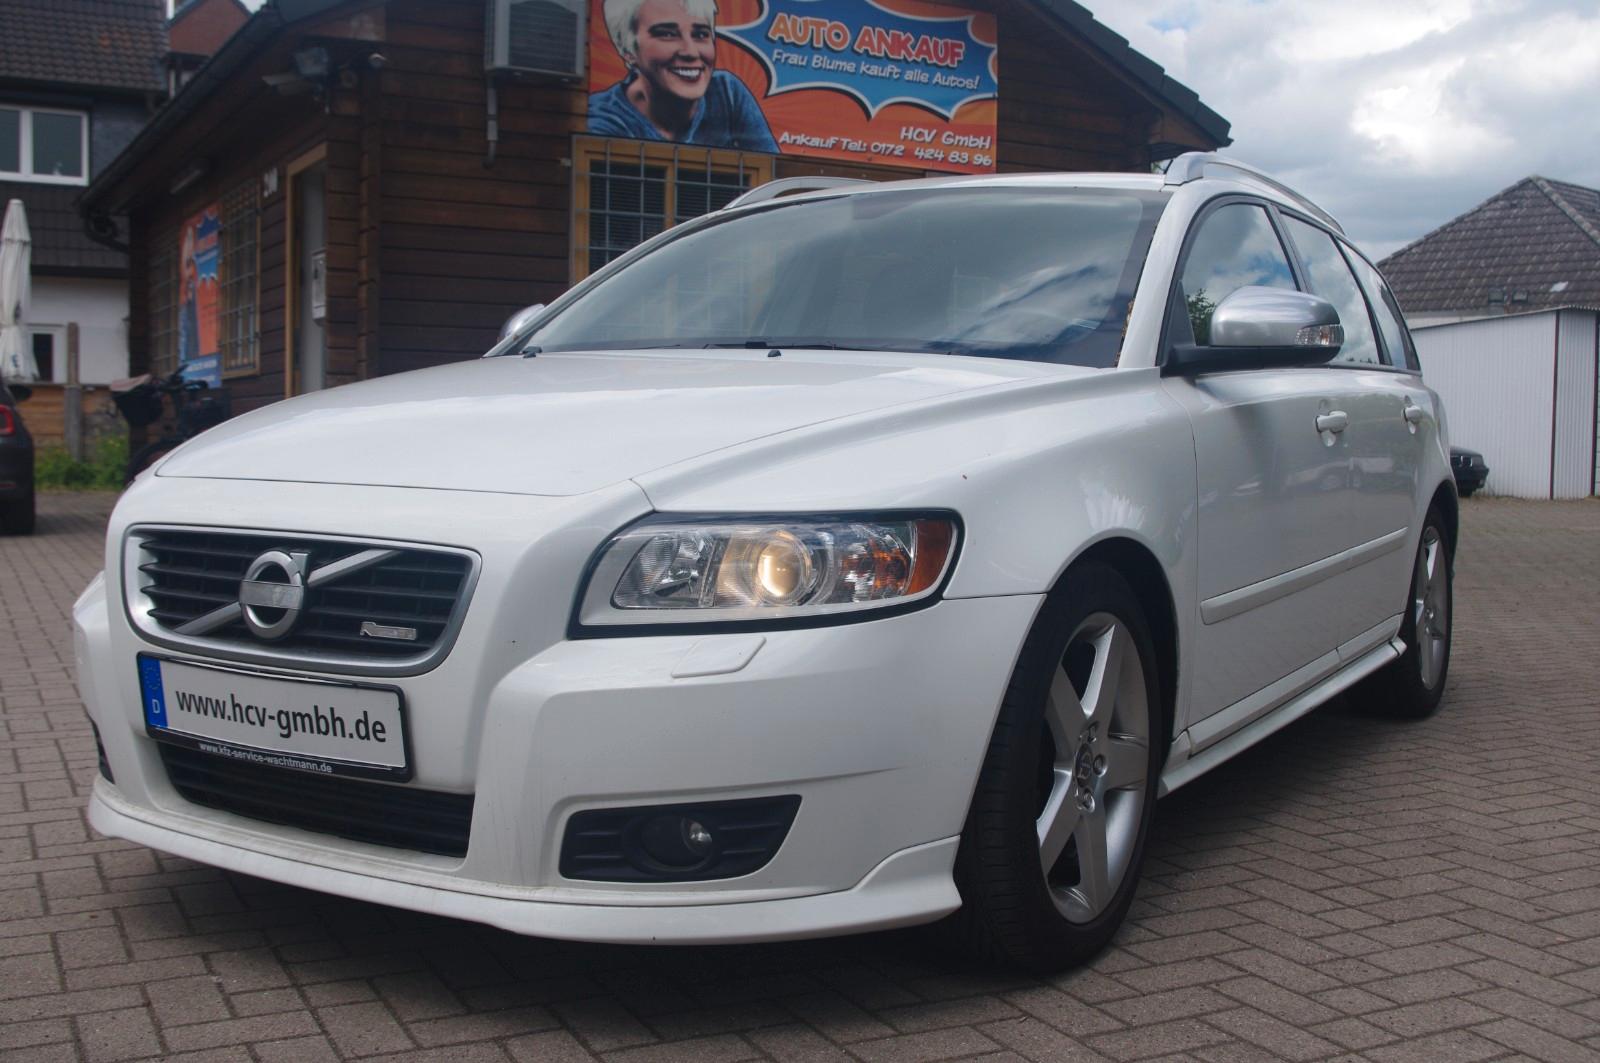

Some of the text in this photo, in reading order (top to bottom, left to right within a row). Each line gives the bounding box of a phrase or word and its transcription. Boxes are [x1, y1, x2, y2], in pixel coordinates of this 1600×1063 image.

[768, 12, 965, 68] AUTO ANKAUF
[772, 48, 980, 90] Frau Blume kauft alle Autos!
[779, 131, 839, 149] Ankauf
[870, 141, 905, 156] 0172
[914, 147, 945, 162] 424
[947, 150, 969, 164] 83
[972, 153, 993, 167] 96
[900, 126, 991, 149] HCV GmbH
[151, 699, 161, 714] D
[175, 690, 387, 743] www.hcv-gmbh.de
[199, 742, 333, 774] www.kfz-service-wachtmann.de
